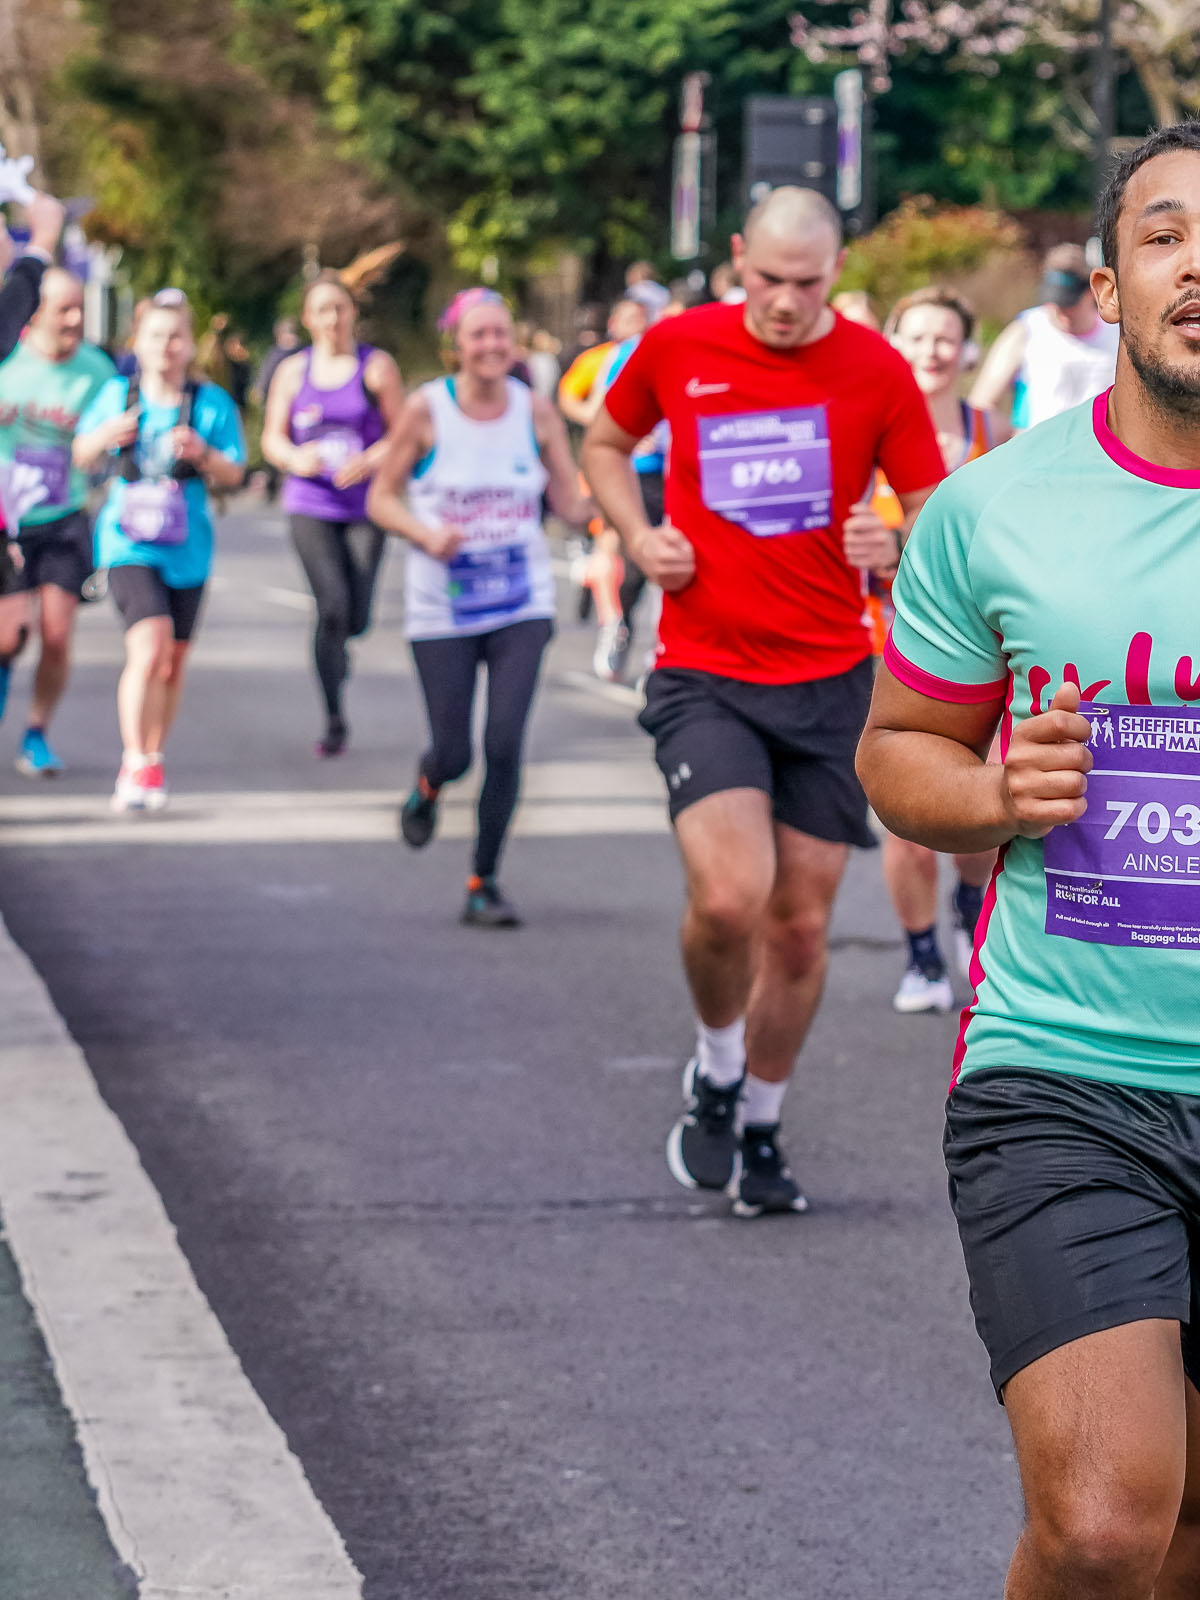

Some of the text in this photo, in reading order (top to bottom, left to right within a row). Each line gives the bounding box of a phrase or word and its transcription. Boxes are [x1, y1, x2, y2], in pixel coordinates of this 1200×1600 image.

[731, 458, 803, 488] 8766
[1120, 733, 1165, 749] HALF
[1055, 882, 1069, 890] Jane
[1055, 888, 1121, 908] RUN FOR ALL
[1131, 931, 1175, 945] Baggage
